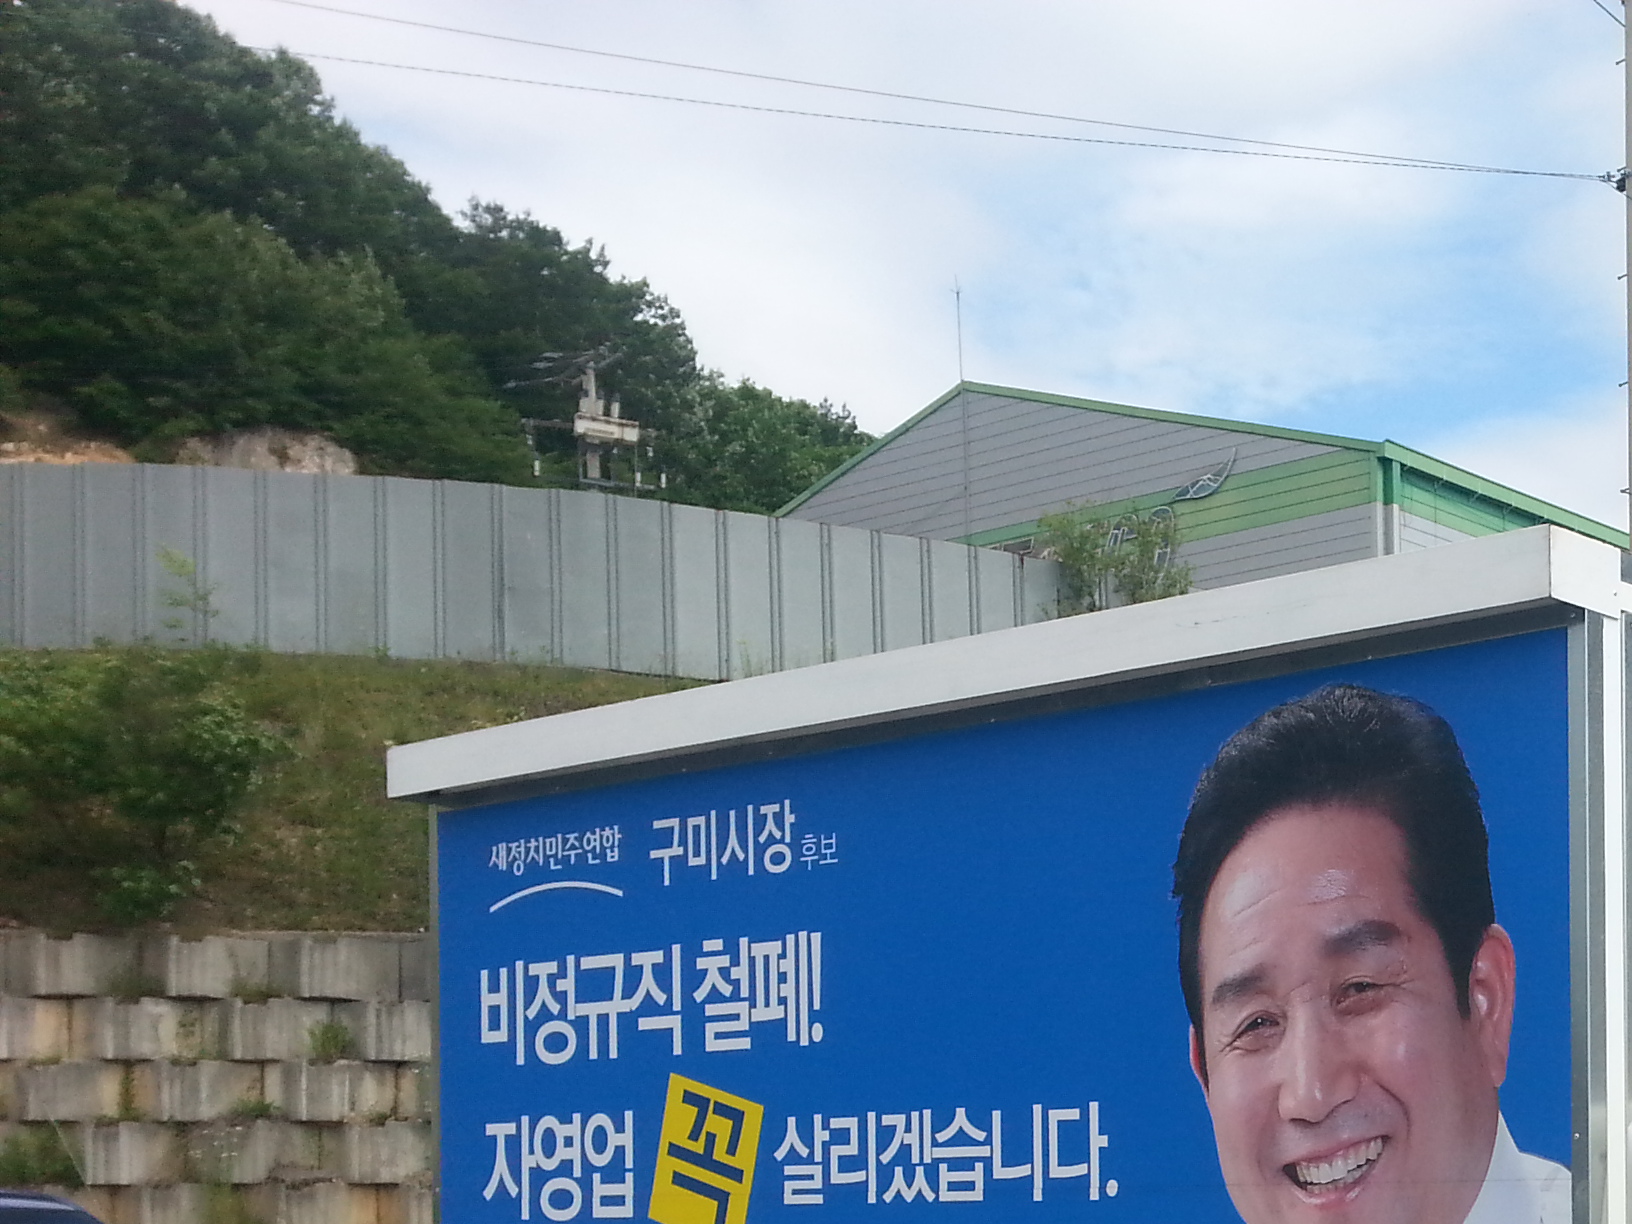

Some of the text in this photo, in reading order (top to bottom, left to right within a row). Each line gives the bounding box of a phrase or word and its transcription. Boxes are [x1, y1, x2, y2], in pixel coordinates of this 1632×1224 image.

[488, 799, 839, 887] 새정치민주연합 구미시장 후보
[479, 931, 824, 1066] 비정규직 철폐!
[483, 1110, 634, 1221] 자영업
[772, 1100, 1120, 1206] 살리겠습니다.
